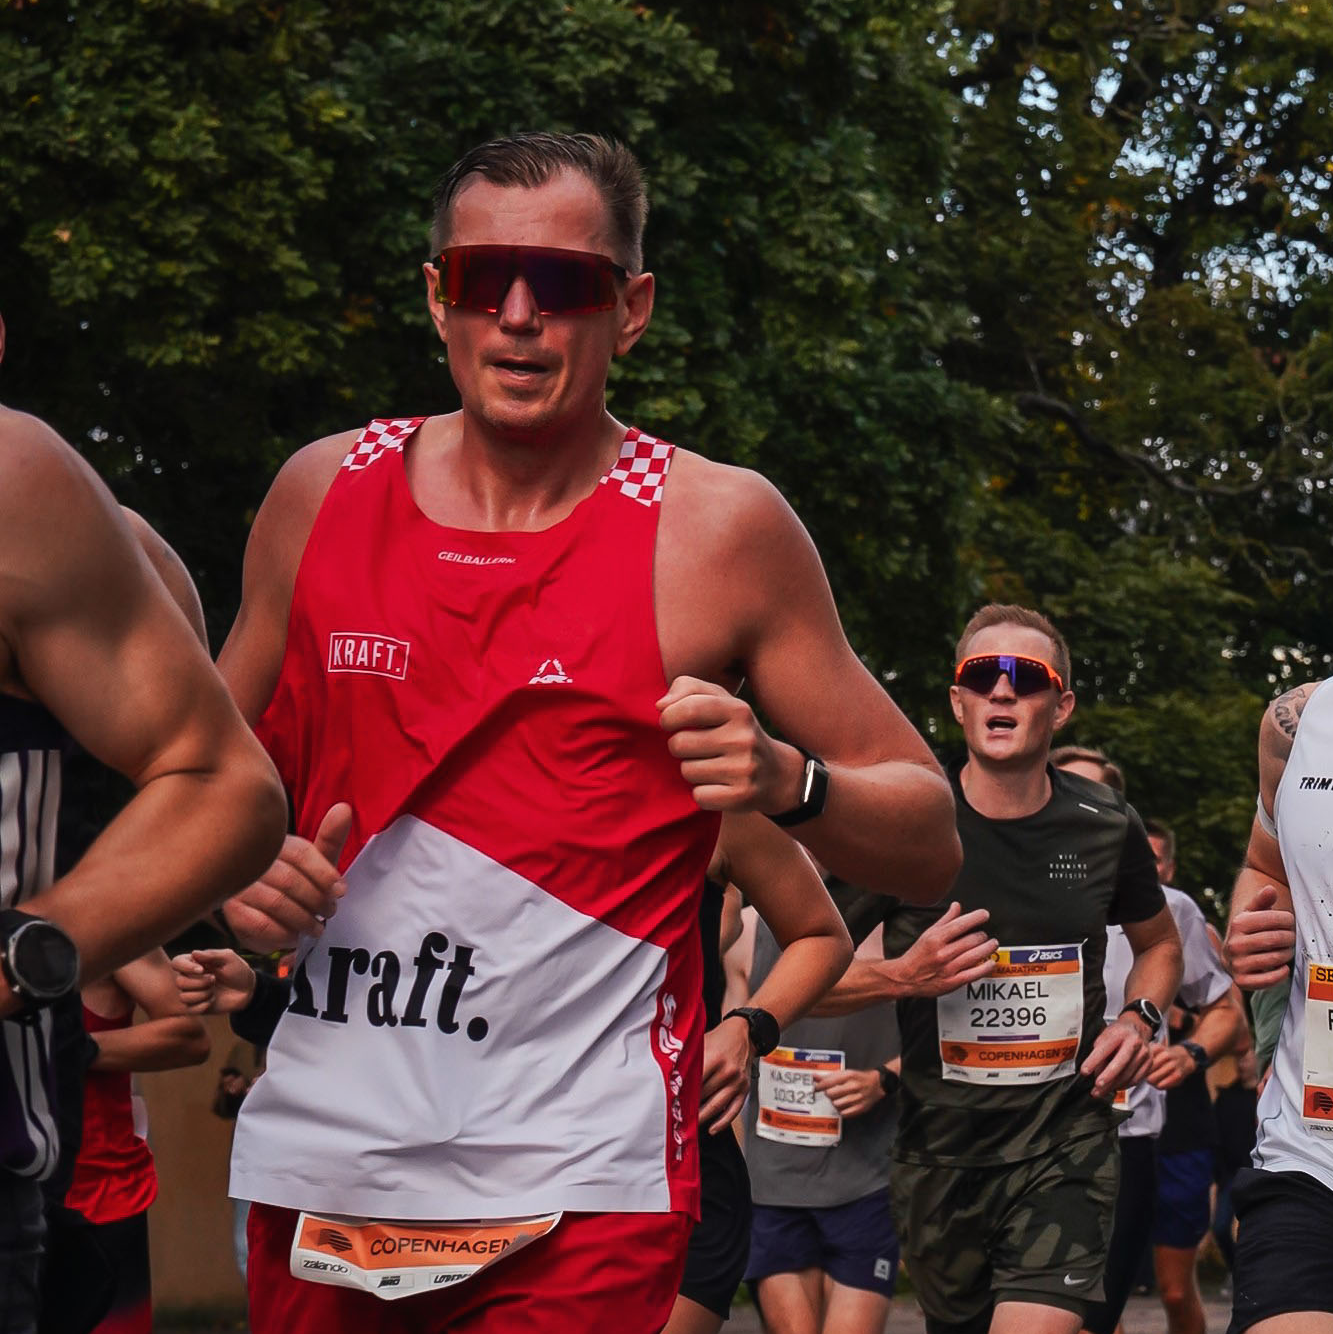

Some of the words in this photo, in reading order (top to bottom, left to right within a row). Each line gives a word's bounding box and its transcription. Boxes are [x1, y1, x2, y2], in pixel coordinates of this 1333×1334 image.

[332, 638, 401, 673] KRAFT.
[966, 981, 1049, 1001] MIKAEL
[970, 1006, 1047, 1028] 22396
[978, 1048, 1060, 1062] COPENHAGEN
[770, 1069, 816, 1086] KASPE
[303, 1259, 349, 1274] zalando
